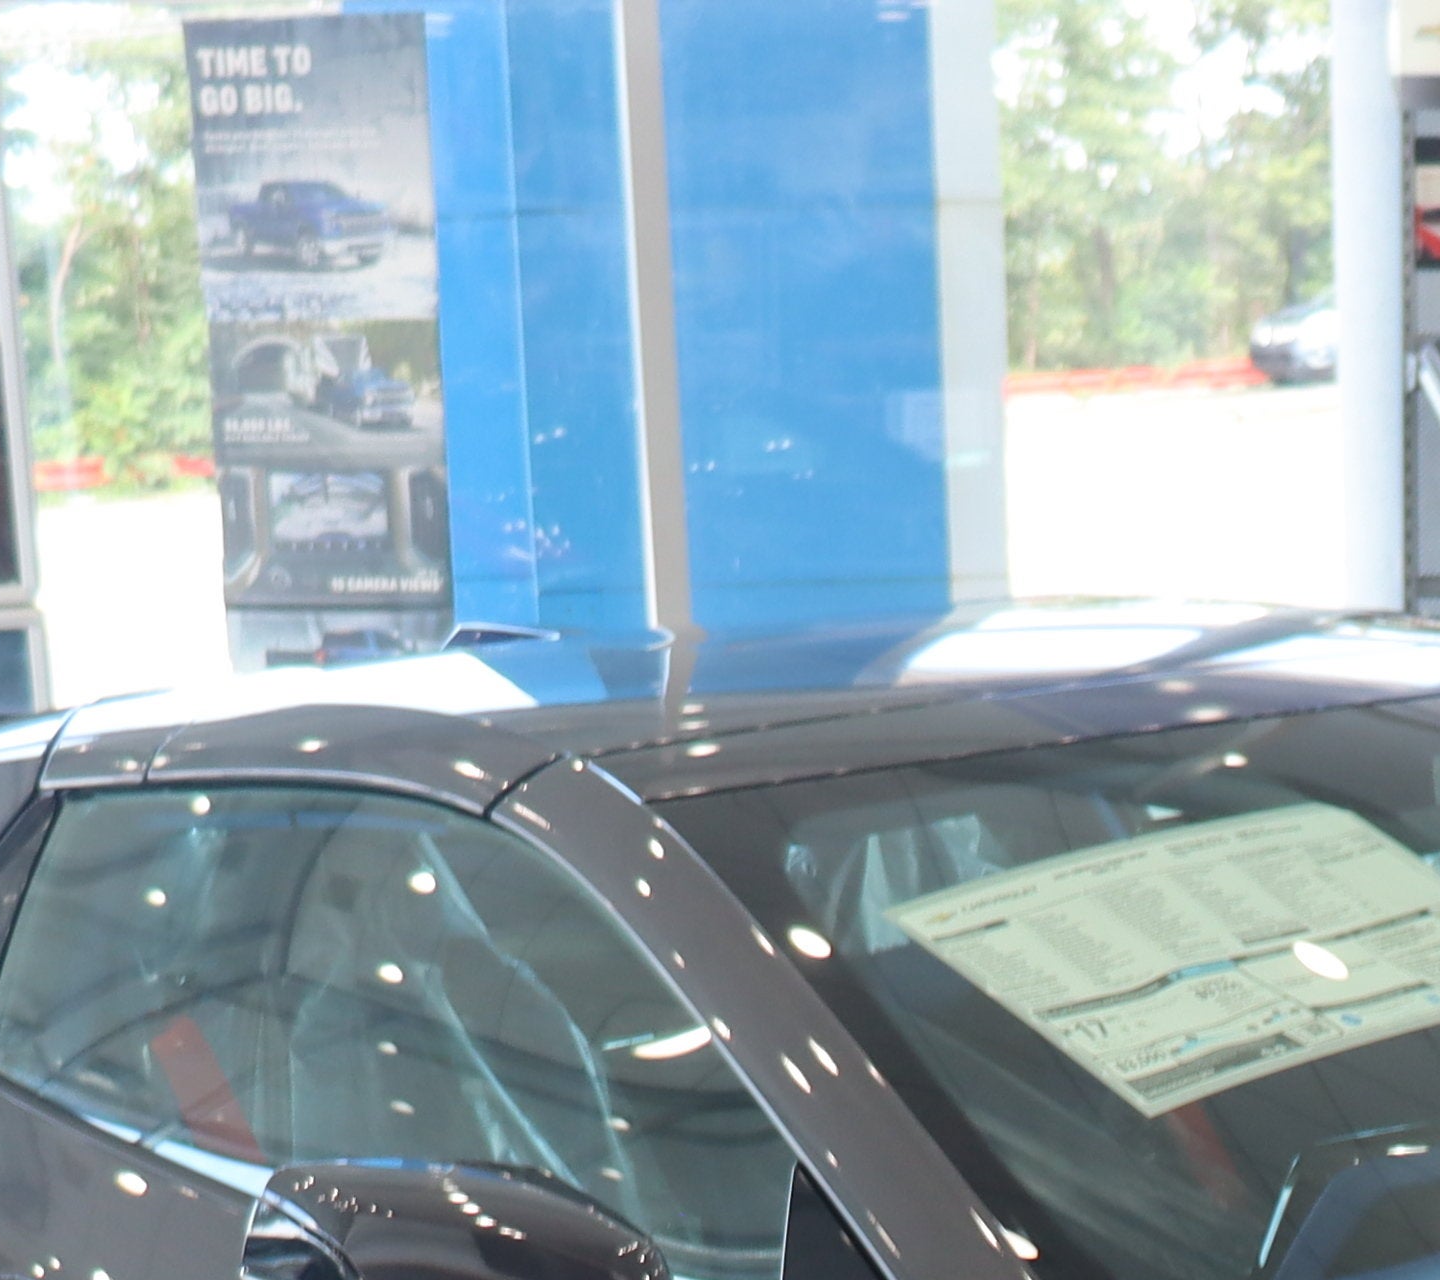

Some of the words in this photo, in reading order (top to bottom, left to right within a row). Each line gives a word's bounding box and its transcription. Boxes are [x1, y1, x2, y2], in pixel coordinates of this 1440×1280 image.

[196, 45, 268, 78] TIME
[272, 43, 312, 76] TO
[199, 84, 239, 116] GO
[243, 81, 303, 113] BIG.
